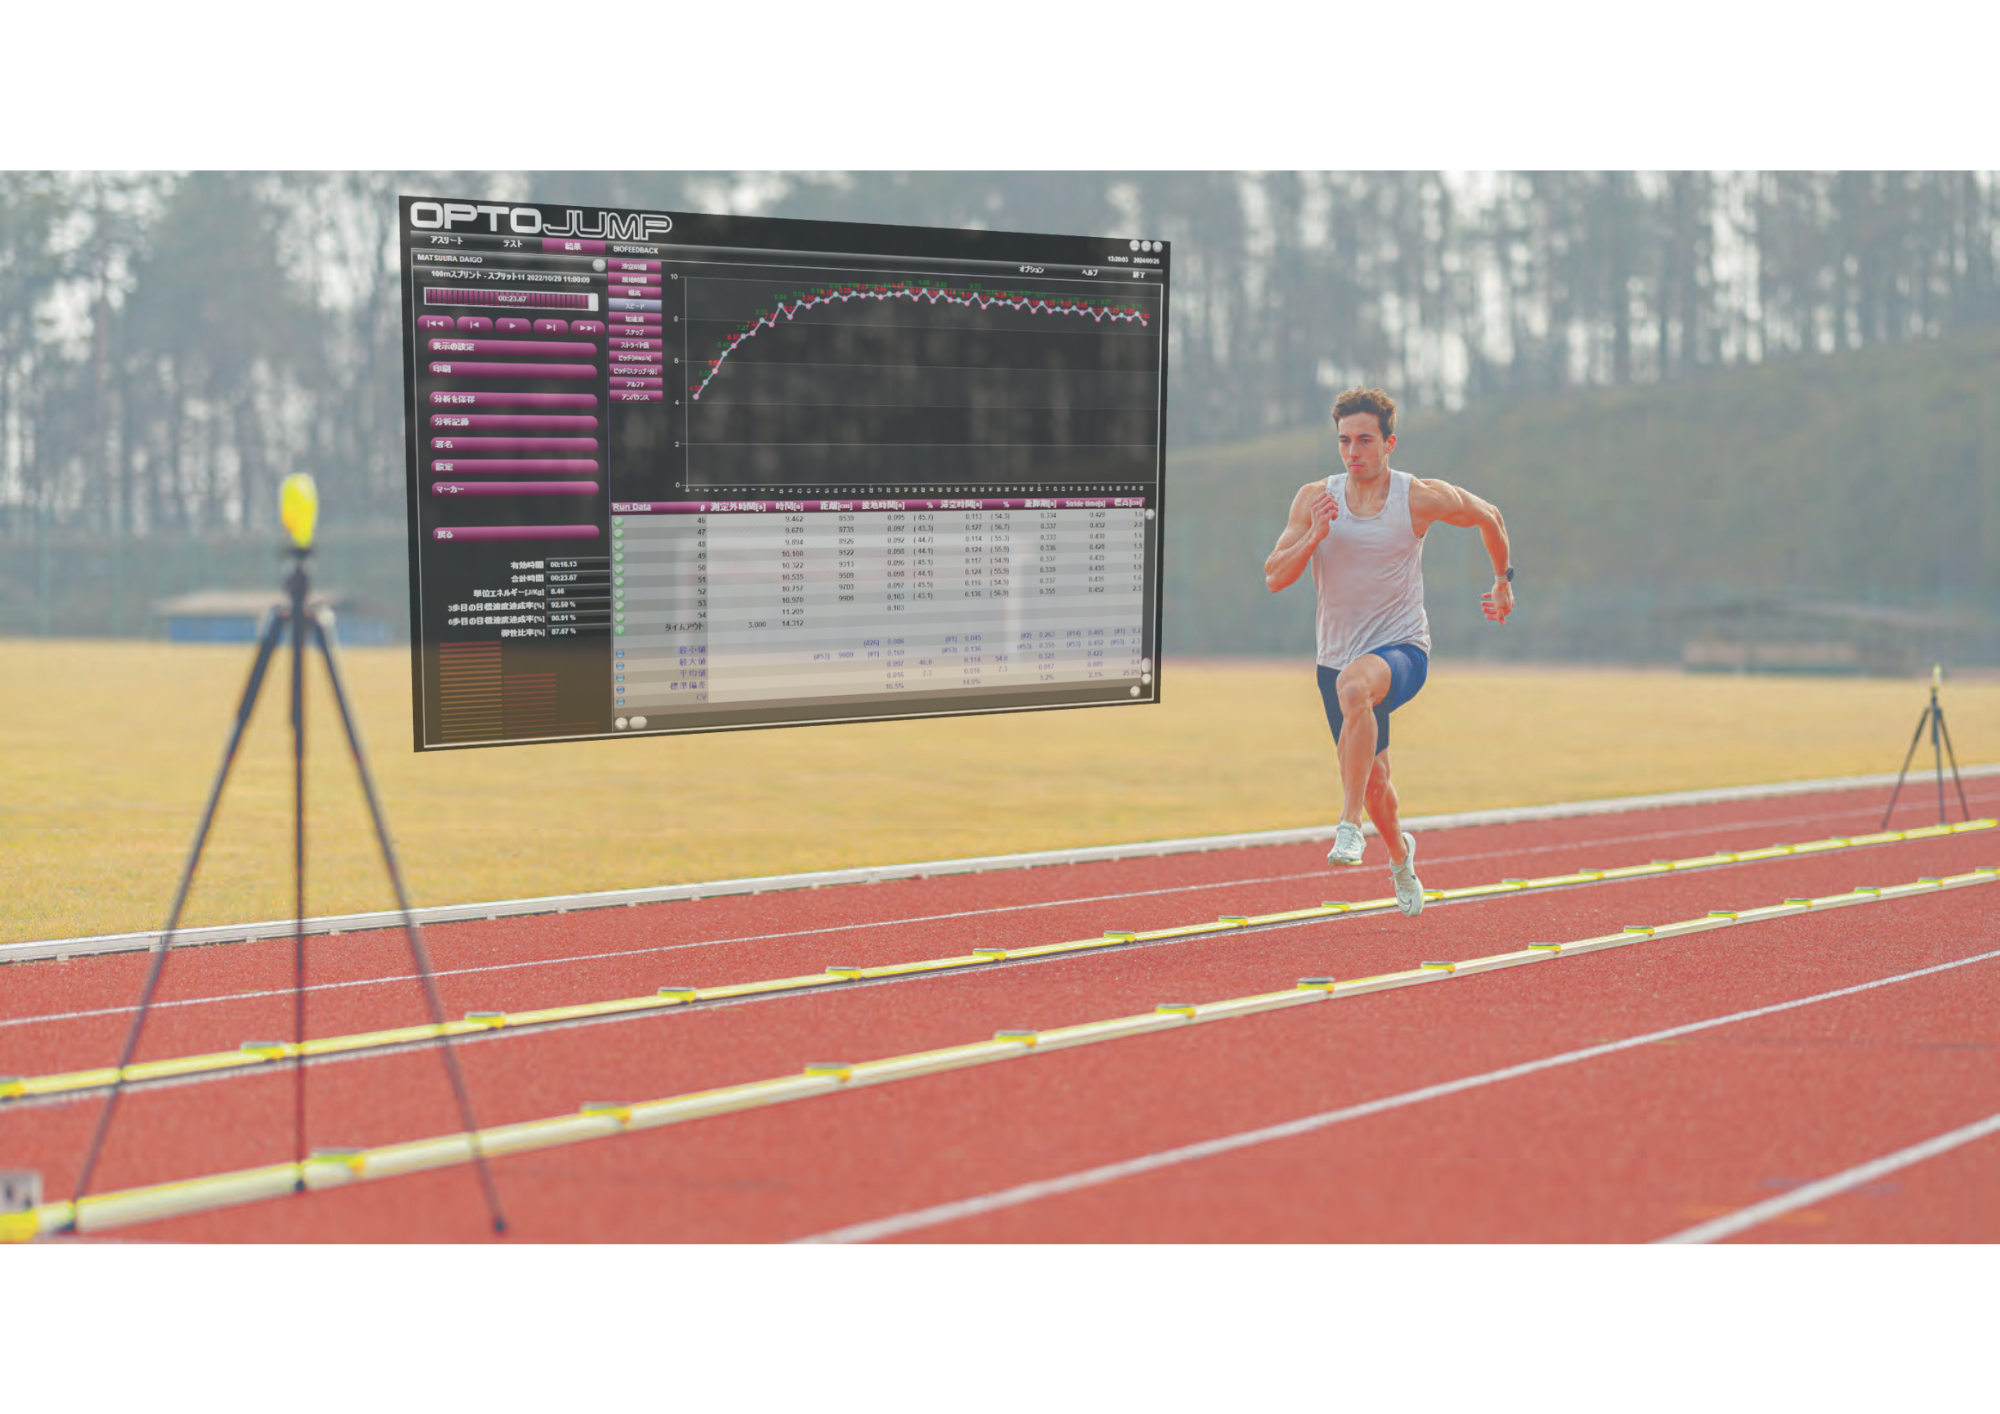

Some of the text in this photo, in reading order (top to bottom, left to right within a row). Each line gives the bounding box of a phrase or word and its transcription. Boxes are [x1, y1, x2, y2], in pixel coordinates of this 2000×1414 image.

[431, 236, 463, 244] アスリート
[503, 240, 522, 248] テスト
[565, 242, 582, 250] 結果
[613, 246, 658, 254] BIOFEEDBACK
[417, 254, 458, 262] MATSUURA
[1019, 265, 1044, 274] オプション
[433, 342, 475, 351] 表示の設定
[433, 364, 451, 373] 印刷
[434, 395, 475, 403] 分析を保存
[434, 418, 469, 426] 分析記録
[435, 463, 453, 471] 設定
[613, 503, 631, 511] Run
[632, 503, 651, 511] Data
[776, 502, 803, 511] 時間[s]
[437, 530, 453, 539] 戻る
[665, 622, 704, 631] タイムアウト
[679, 646, 706, 654] 最小値
[679, 658, 706, 666] 最大値
[680, 669, 706, 678] 平均値
